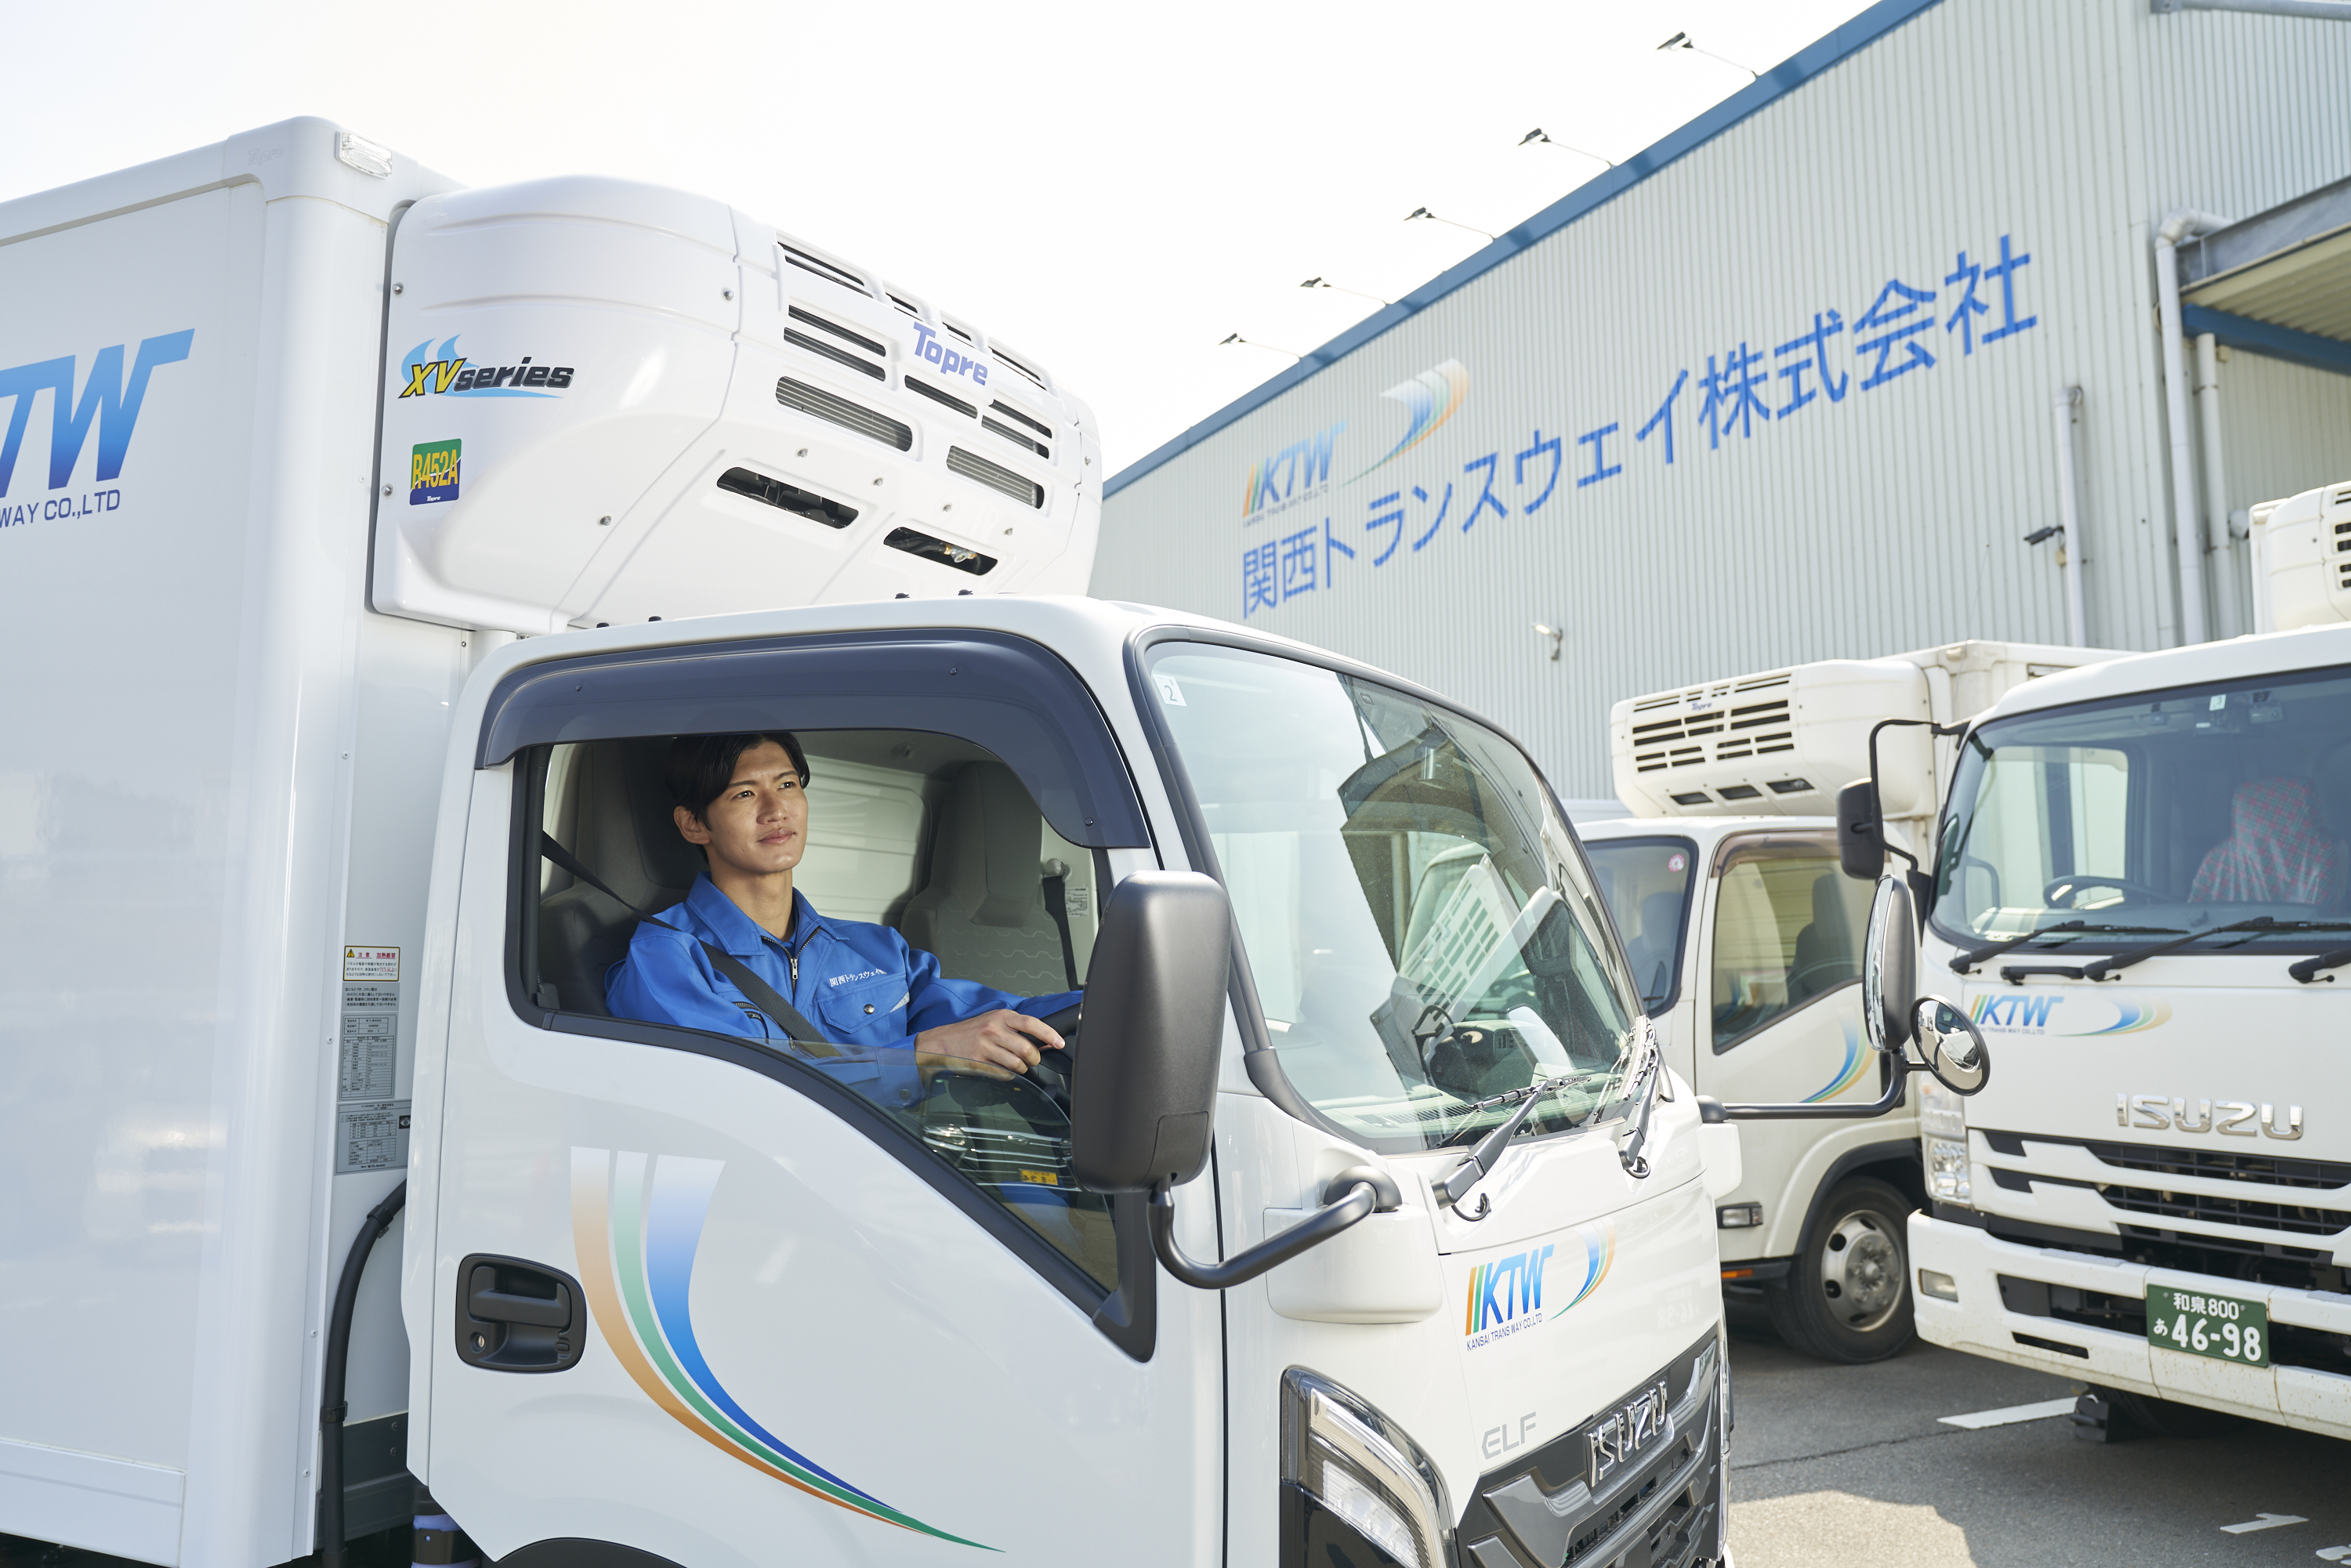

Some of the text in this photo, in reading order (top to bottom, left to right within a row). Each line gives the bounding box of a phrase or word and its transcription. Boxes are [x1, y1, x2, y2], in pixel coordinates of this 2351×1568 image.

[248, 147, 284, 165] Topre
[913, 321, 989, 386] Topre
[0, 328, 195, 498] TW
[1243, 233, 2038, 619] 関西トランスウェイ株式会社
[412, 448, 458, 490] R452A
[0, 489, 121, 529] WAY CO.,LTD
[1164, 684, 1178, 702] 2
[1980, 994, 2064, 1027] KTW
[2116, 1092, 2304, 1141] ISUZU
[1481, 1244, 1555, 1331] KTW
[1466, 1334, 1491, 1352] KANSAI
[1491, 1326, 1510, 1342] TRANS
[1511, 1320, 1522, 1334] WAY
[2154, 1314, 2262, 1361] あ 46-98
[1481, 1411, 1537, 1460] ELF
[1588, 1380, 1668, 1488] ISUZU
